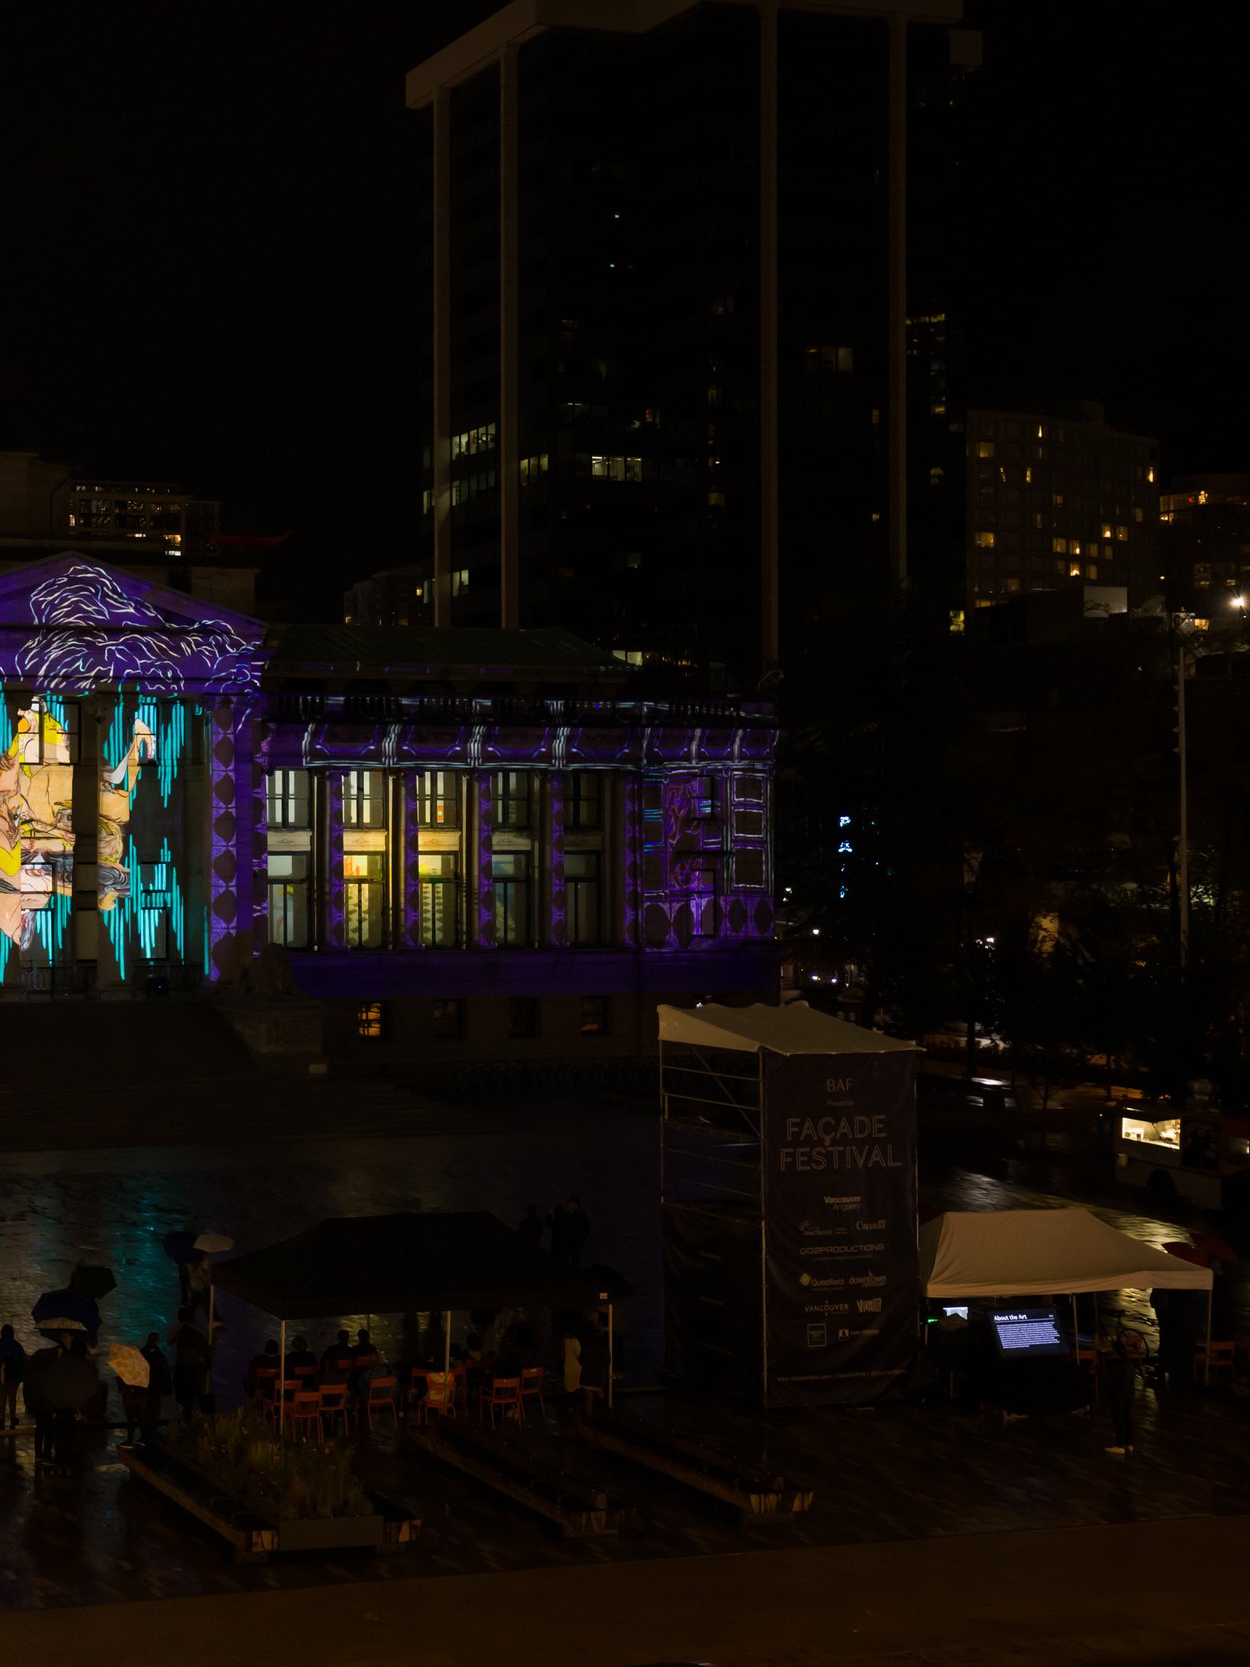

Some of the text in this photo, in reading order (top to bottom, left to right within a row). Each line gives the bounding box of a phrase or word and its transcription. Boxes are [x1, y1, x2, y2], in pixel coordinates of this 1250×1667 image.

[826, 1078, 853, 1092] BAF
[786, 1114, 887, 1146] FAÇADE
[780, 1143, 903, 1171] FESTIVAL
[823, 1195, 861, 1204] Vancouver
[804, 1303, 850, 1313] VANCOUVER
[994, 1314, 1009, 1322] About
